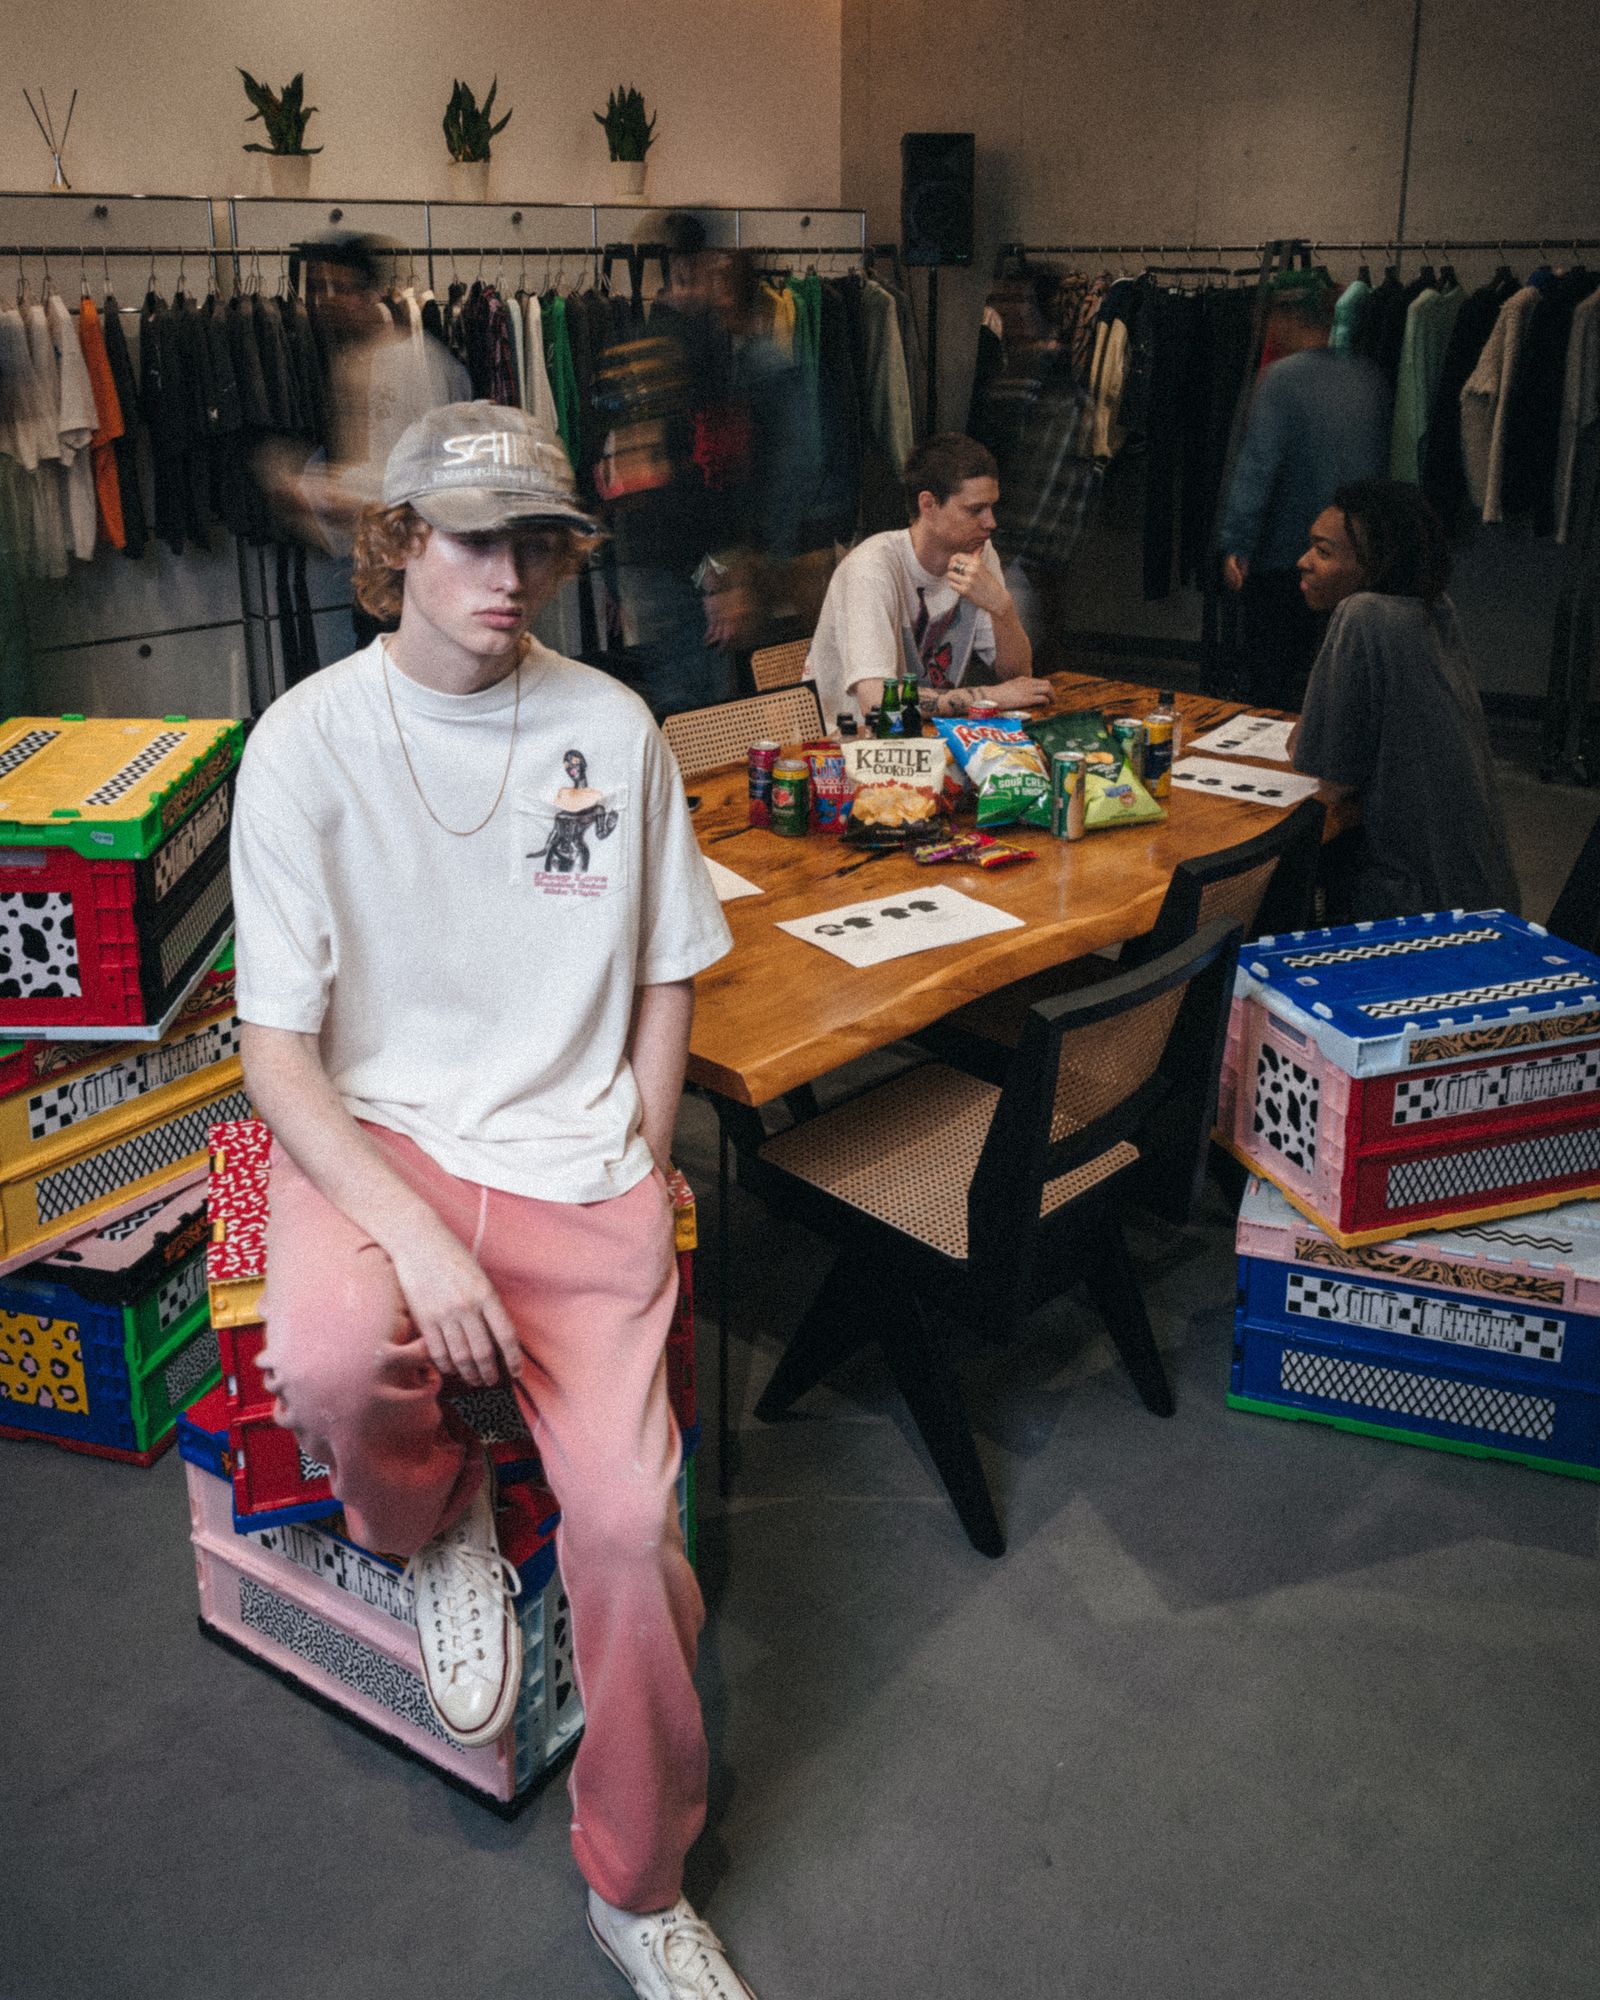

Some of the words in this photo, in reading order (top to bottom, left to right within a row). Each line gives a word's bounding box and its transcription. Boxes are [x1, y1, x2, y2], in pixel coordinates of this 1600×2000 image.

[855, 748, 932, 773] KETTLE
[873, 764, 915, 777] COOKED
[1330, 1283, 1401, 1328] SAINT
